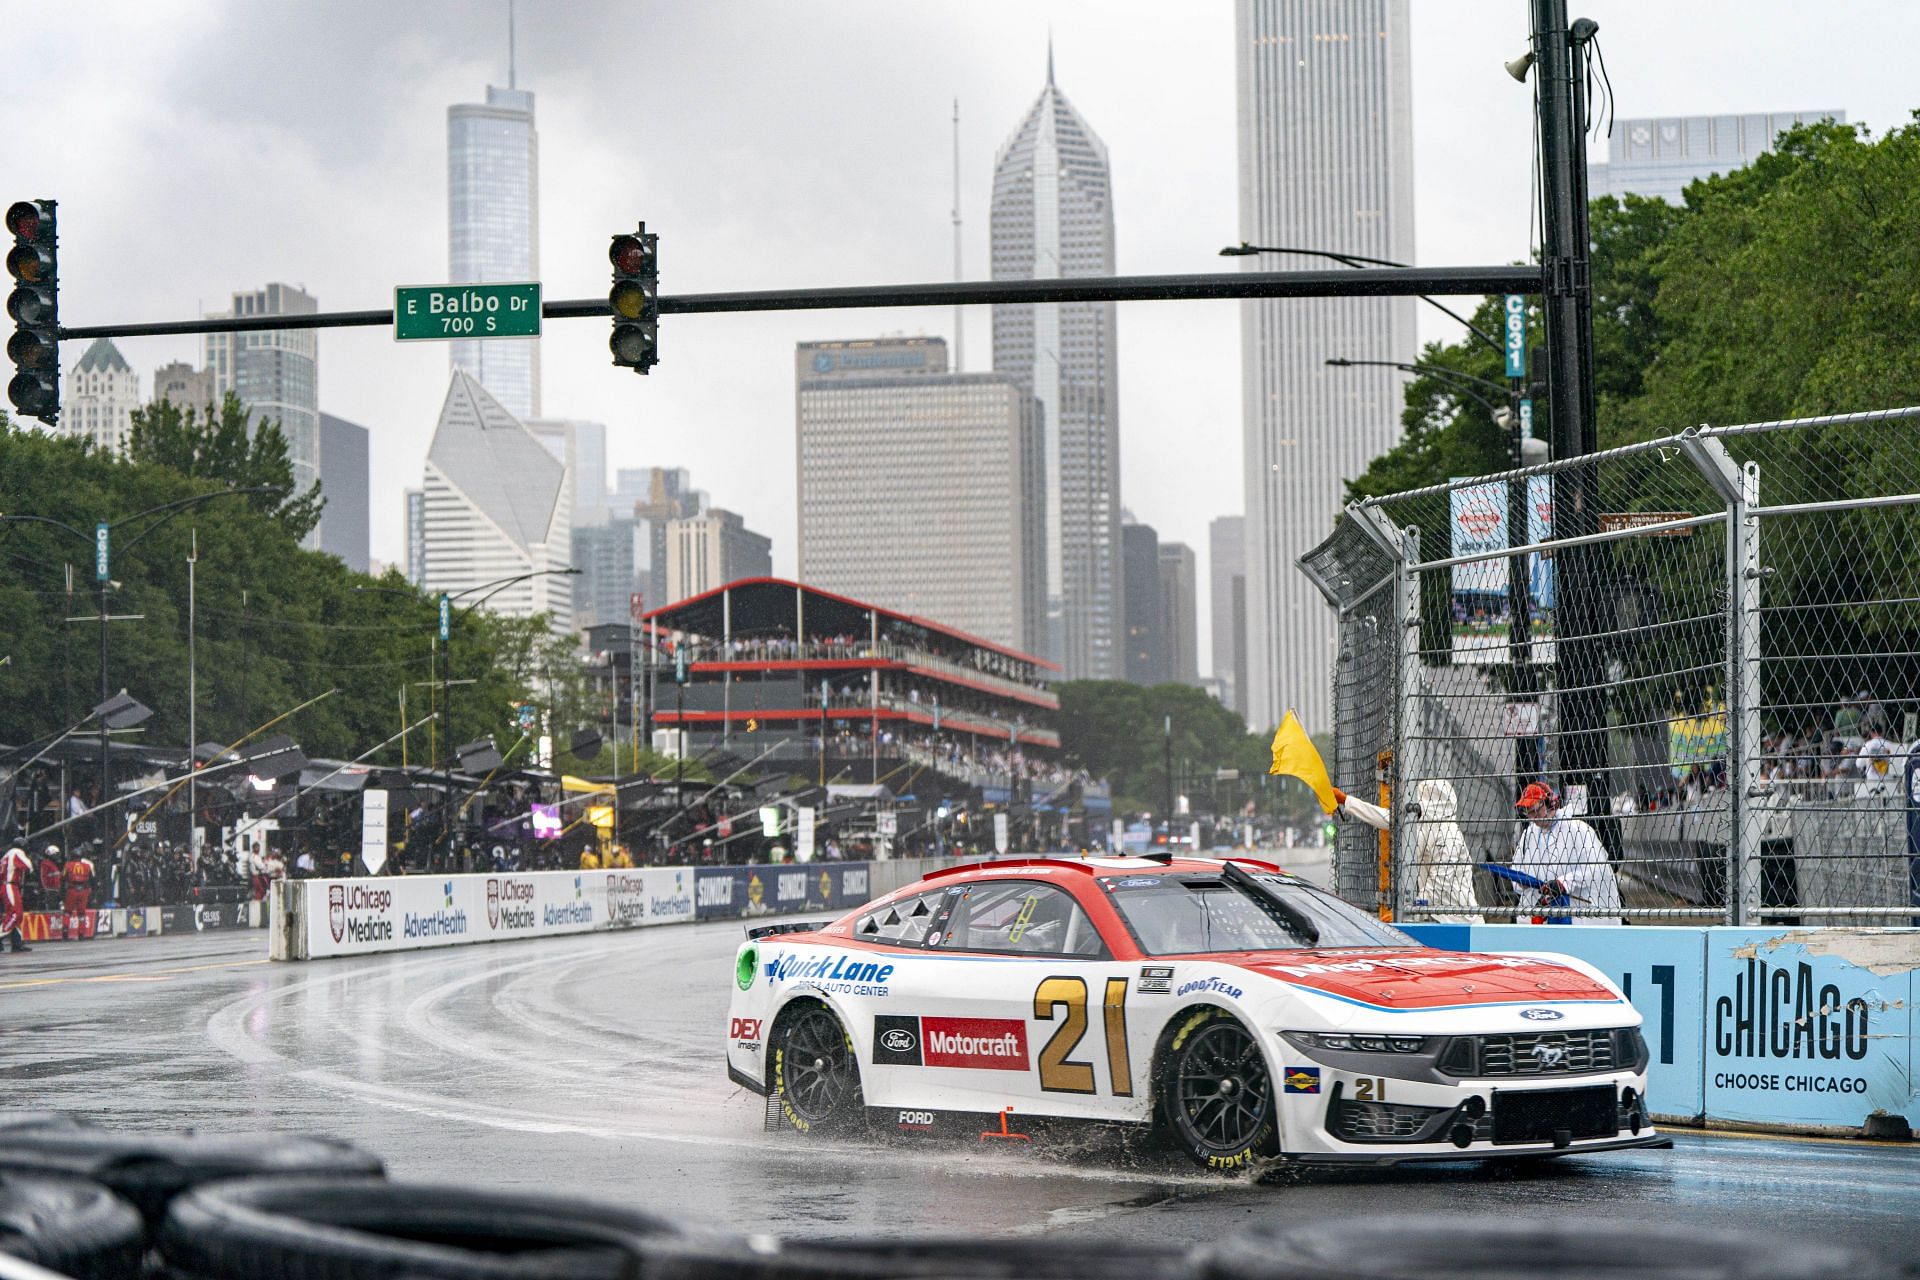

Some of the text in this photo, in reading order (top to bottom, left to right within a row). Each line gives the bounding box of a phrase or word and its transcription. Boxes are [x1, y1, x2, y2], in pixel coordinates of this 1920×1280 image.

[407, 291, 528, 314] E Balbo Dr
[441, 316, 496, 332] 700 S
[1506, 295, 1524, 369] C631
[347, 884, 391, 912] UChicago
[500, 877, 534, 904] UChicago
[404, 910, 467, 938] AdventHealth
[501, 906, 534, 929] Medicine
[544, 901, 592, 926] AdventHealth
[348, 915, 392, 943] Medicine
[824, 983, 851, 994] AUTO
[853, 986, 889, 997] CENTER
[1652, 965, 1675, 1064] 1
[730, 1018, 763, 1040] DEX
[1033, 975, 1133, 1097] 21
[929, 1031, 1020, 1056] Motorcraft
[1355, 1078, 1385, 1101] 21
[1715, 1073, 1867, 1093] CHOOSE CHICAGO
[899, 1111, 934, 1125] FORD
[1207, 1147, 1252, 1168] EAGLE
